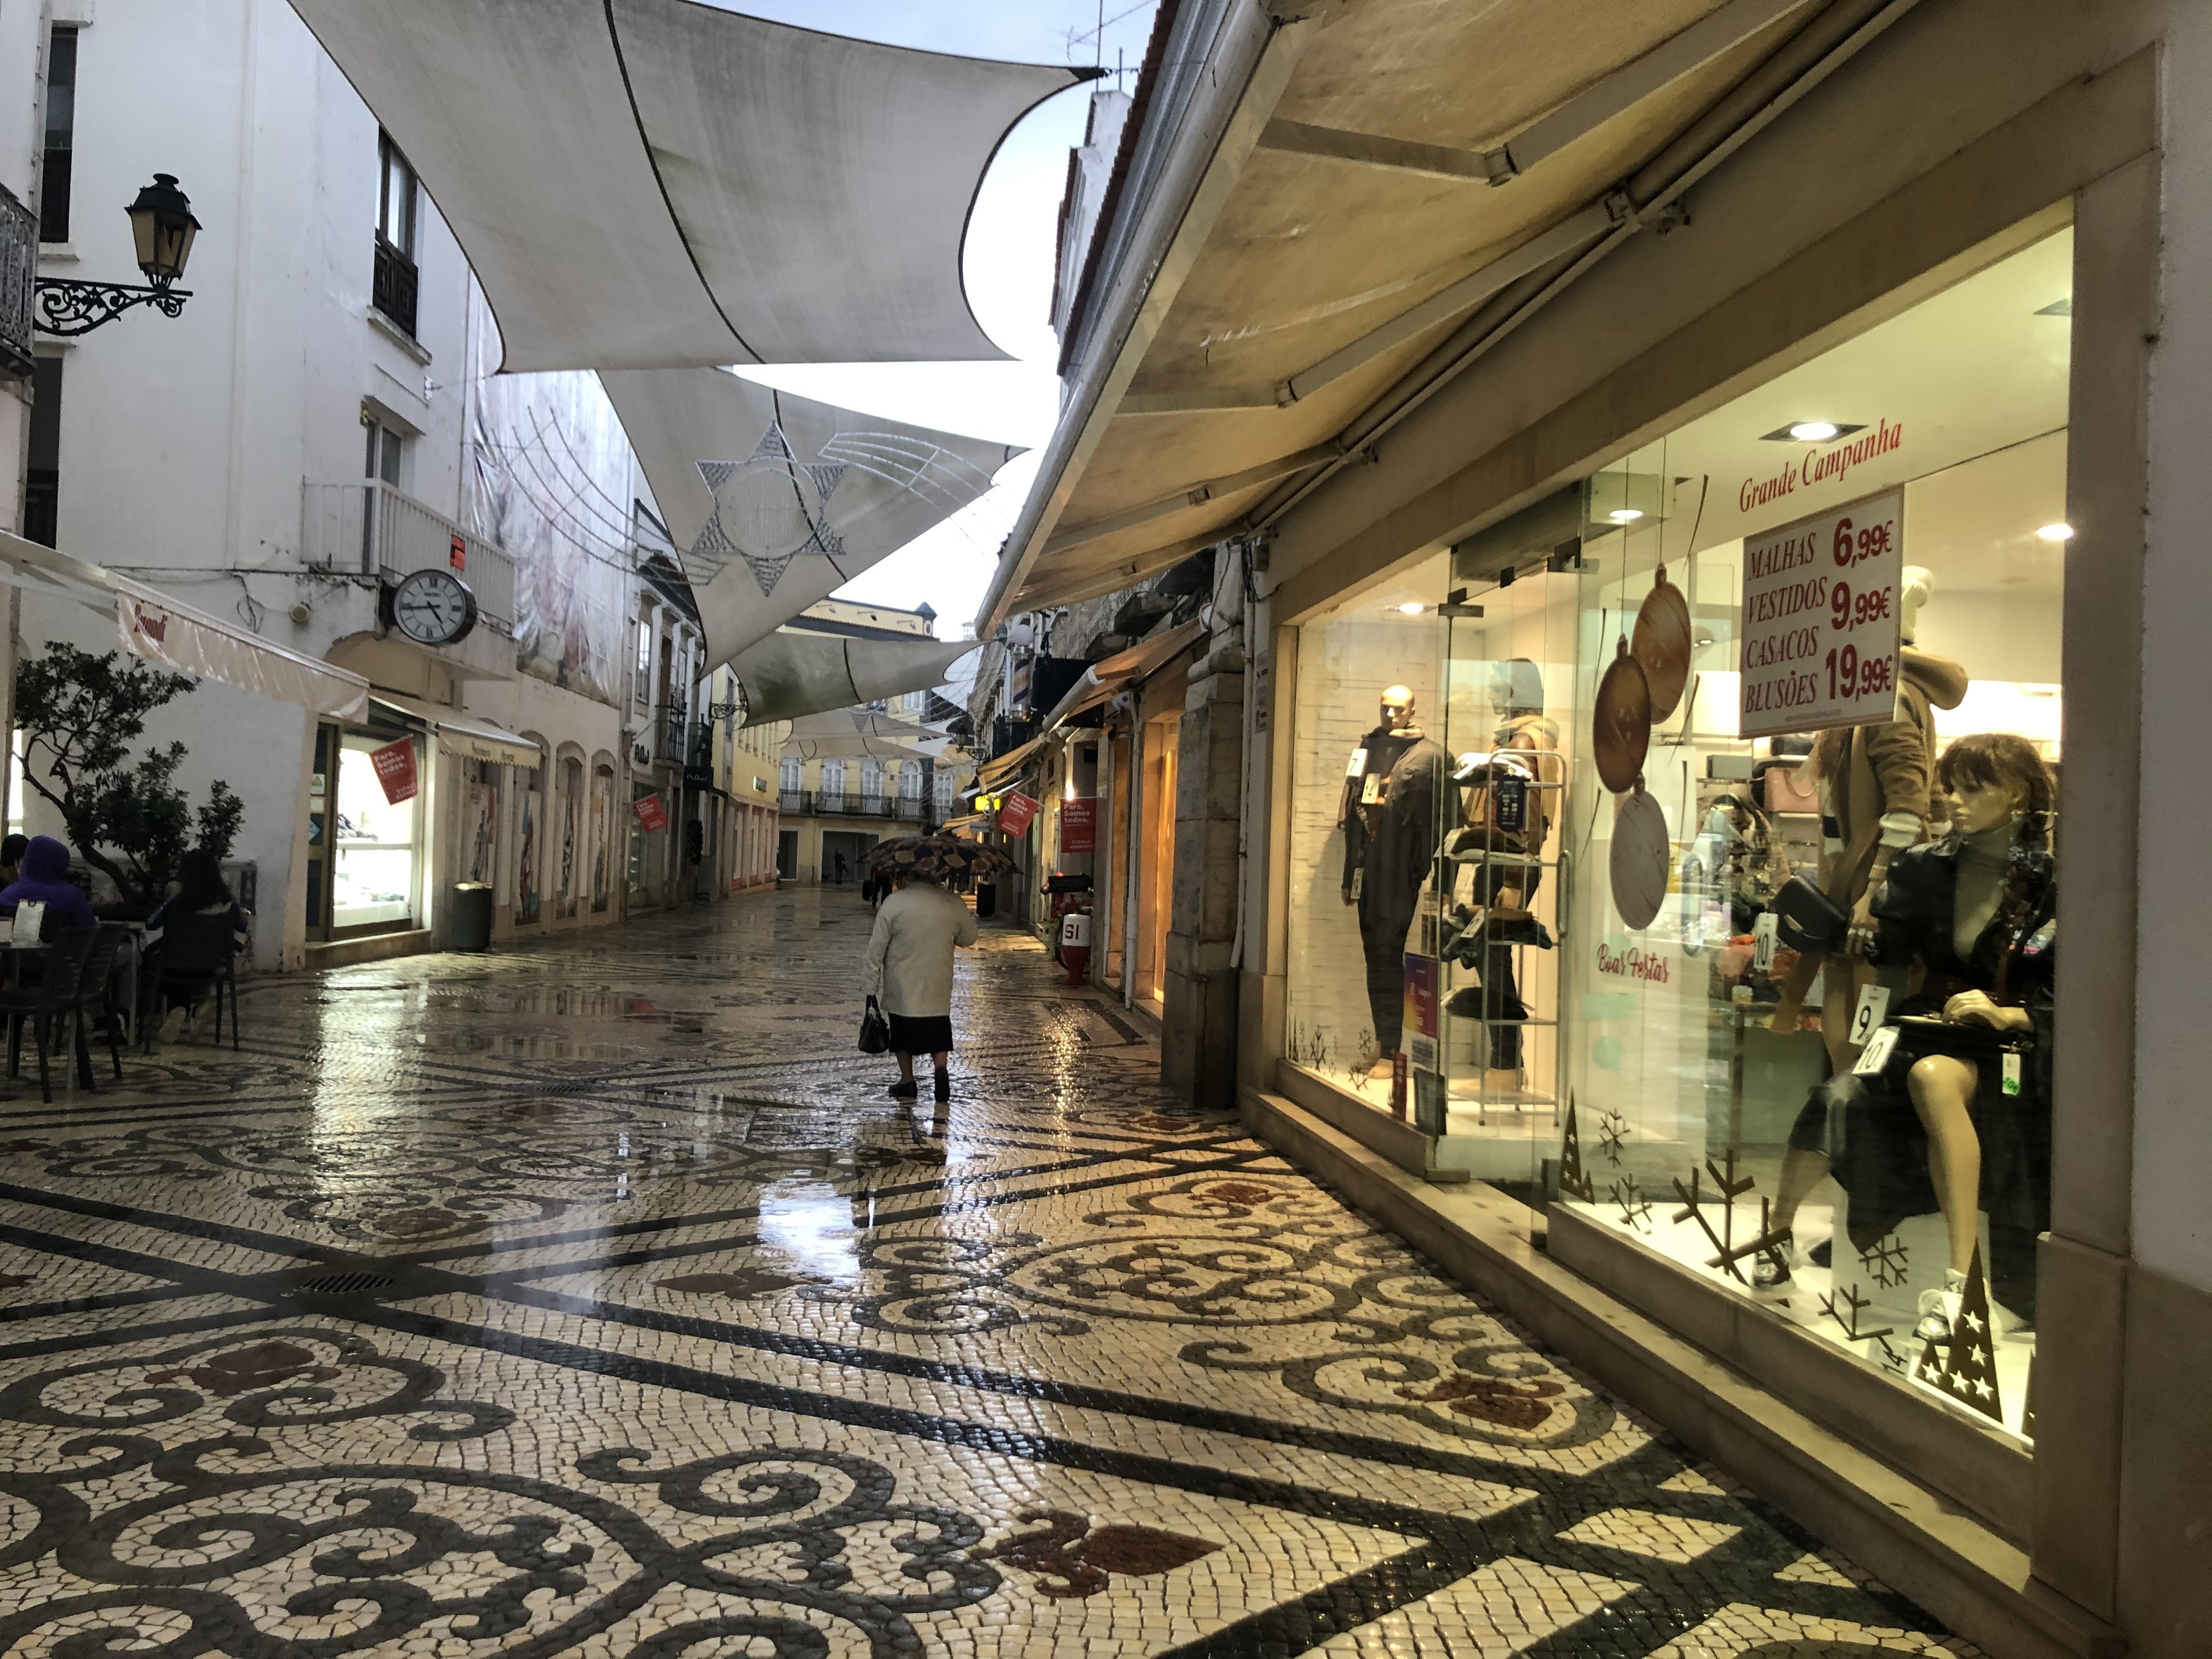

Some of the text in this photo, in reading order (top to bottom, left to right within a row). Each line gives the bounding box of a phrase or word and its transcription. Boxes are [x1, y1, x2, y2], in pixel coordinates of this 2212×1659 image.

[1739, 418, 1903, 513] Grande Campanha
[1747, 517, 1893, 581] MALHAS 6,99€
[1748, 576, 1892, 632] VESTIDOS 9,99€
[1746, 625, 1819, 669] CASACOS
[1825, 644, 1893, 703] 19,99€
[1744, 670, 1818, 713] BLUSÕES
[1597, 943, 1670, 984] Boas Festas
